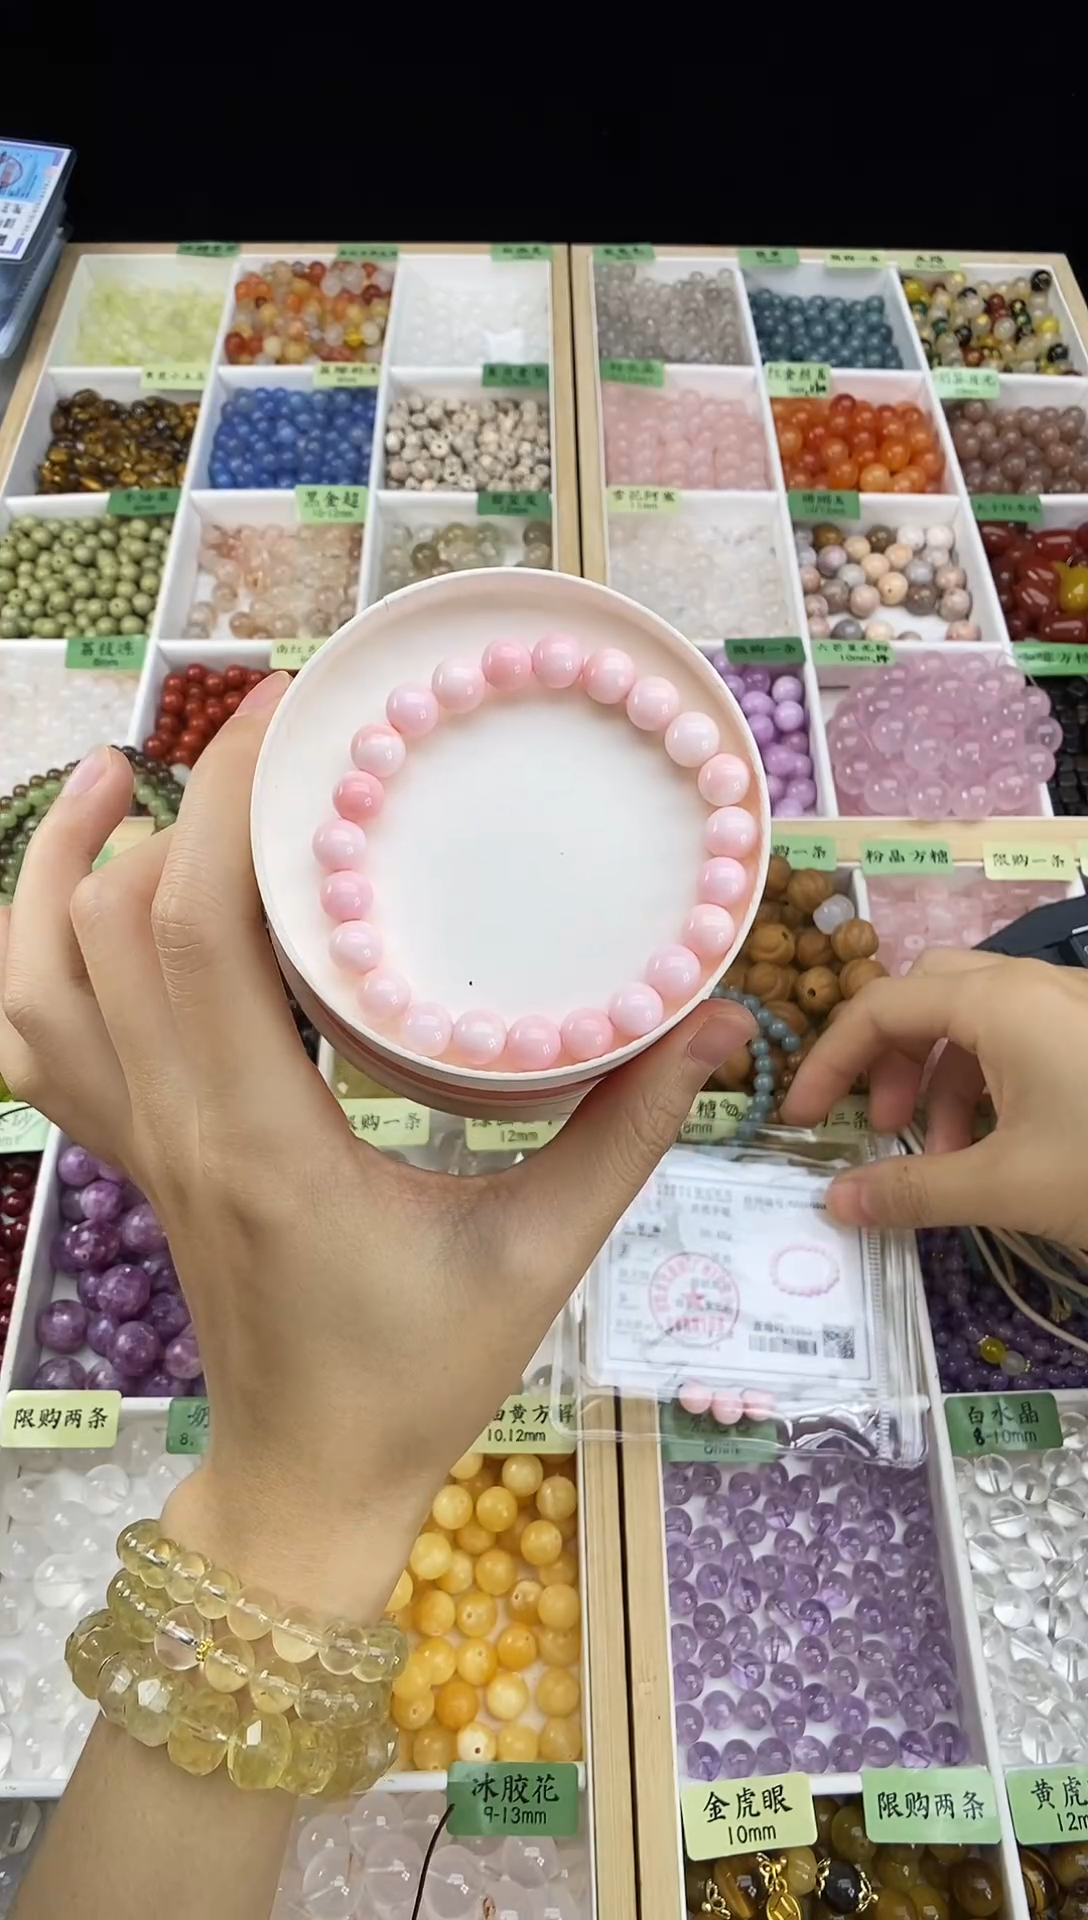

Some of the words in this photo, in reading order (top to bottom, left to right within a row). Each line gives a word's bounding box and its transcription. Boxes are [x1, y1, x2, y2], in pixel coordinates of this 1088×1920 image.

[866, 849, 948, 864] 粉晶方糖
[993, 853, 1065, 868] 限购一条
[696, 1099, 717, 1120] 糖
[13, 1407, 109, 1430] 限购两条
[967, 1401, 1040, 1426] 白水晶
[487, 1429, 547, 1443] 10.12mm
[972, 1428, 1038, 1446] 8-10mm
[471, 1772, 560, 1804] 冰胶花
[1031, 1776, 1088, 1811] 黄虎
[703, 1784, 794, 1823] 金虎眼
[877, 1790, 985, 1820] 限购两条
[483, 1806, 547, 1825] 9-13mm
[728, 1825, 777, 1845] 10mm
